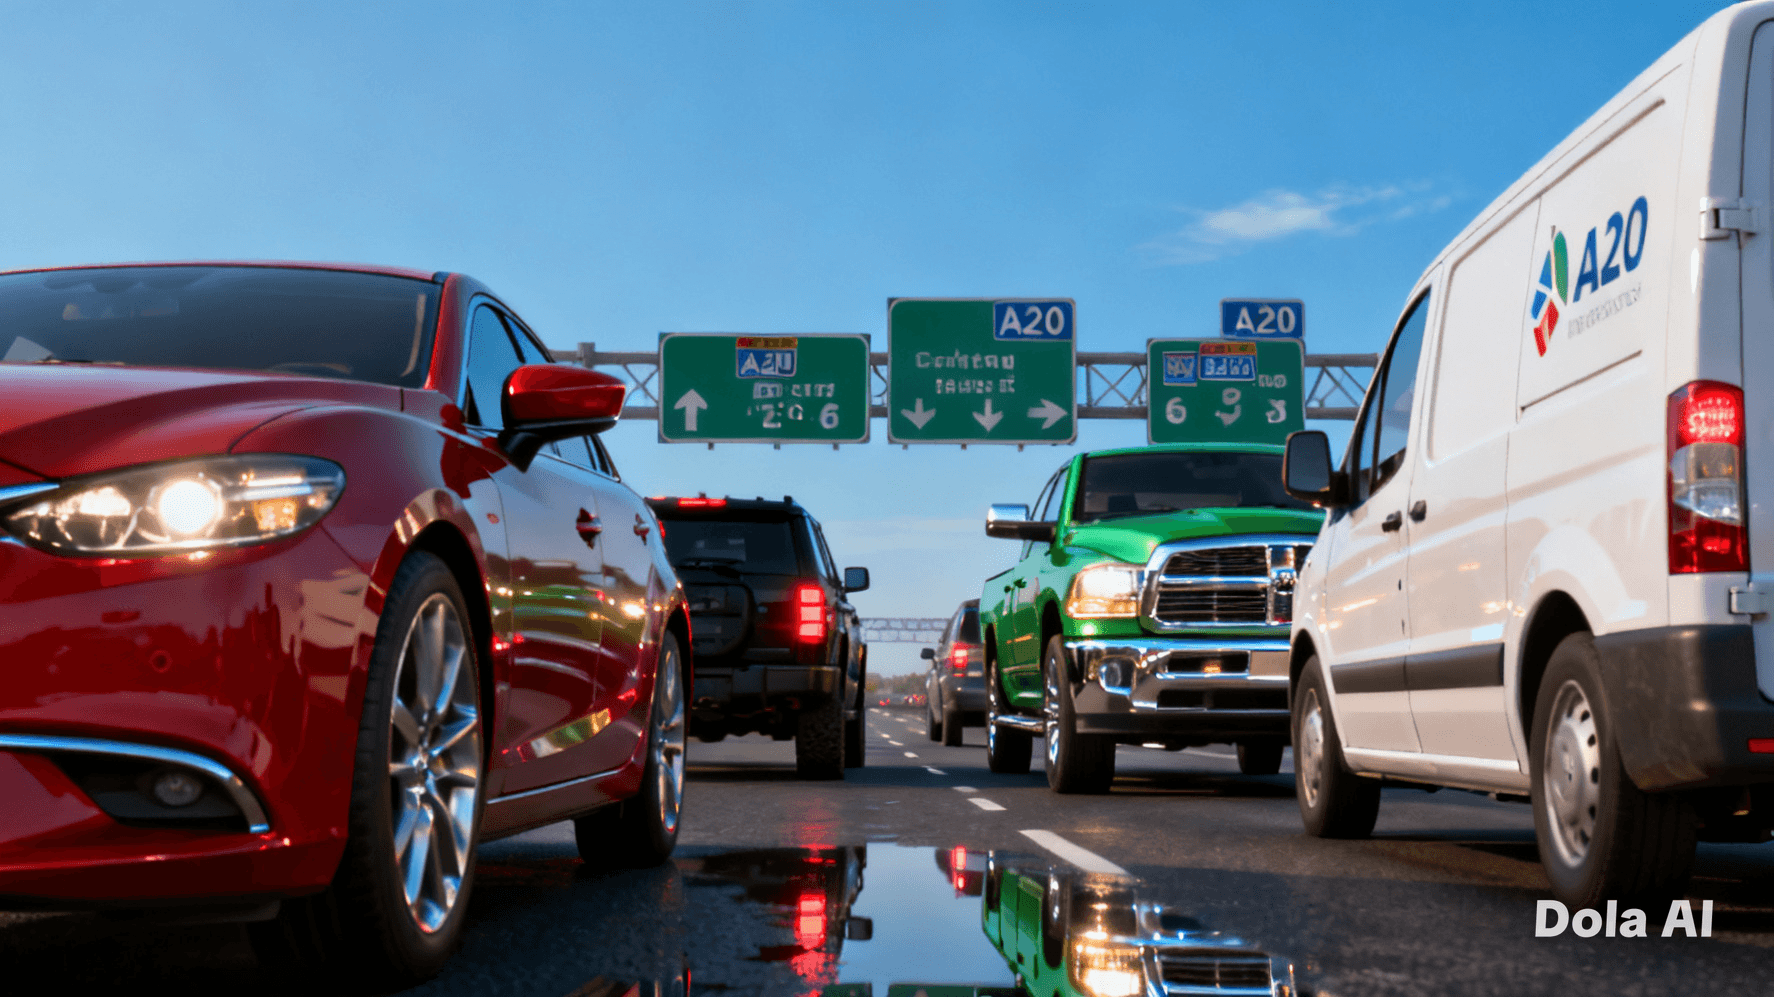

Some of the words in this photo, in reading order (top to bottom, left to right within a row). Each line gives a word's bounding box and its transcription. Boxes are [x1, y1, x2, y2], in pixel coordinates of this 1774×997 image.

[1573, 195, 1648, 303] A20
[999, 306, 1065, 335] A20
[1236, 305, 1296, 334] A20
[820, 403, 839, 429] 6
[1165, 397, 1187, 424] 6
